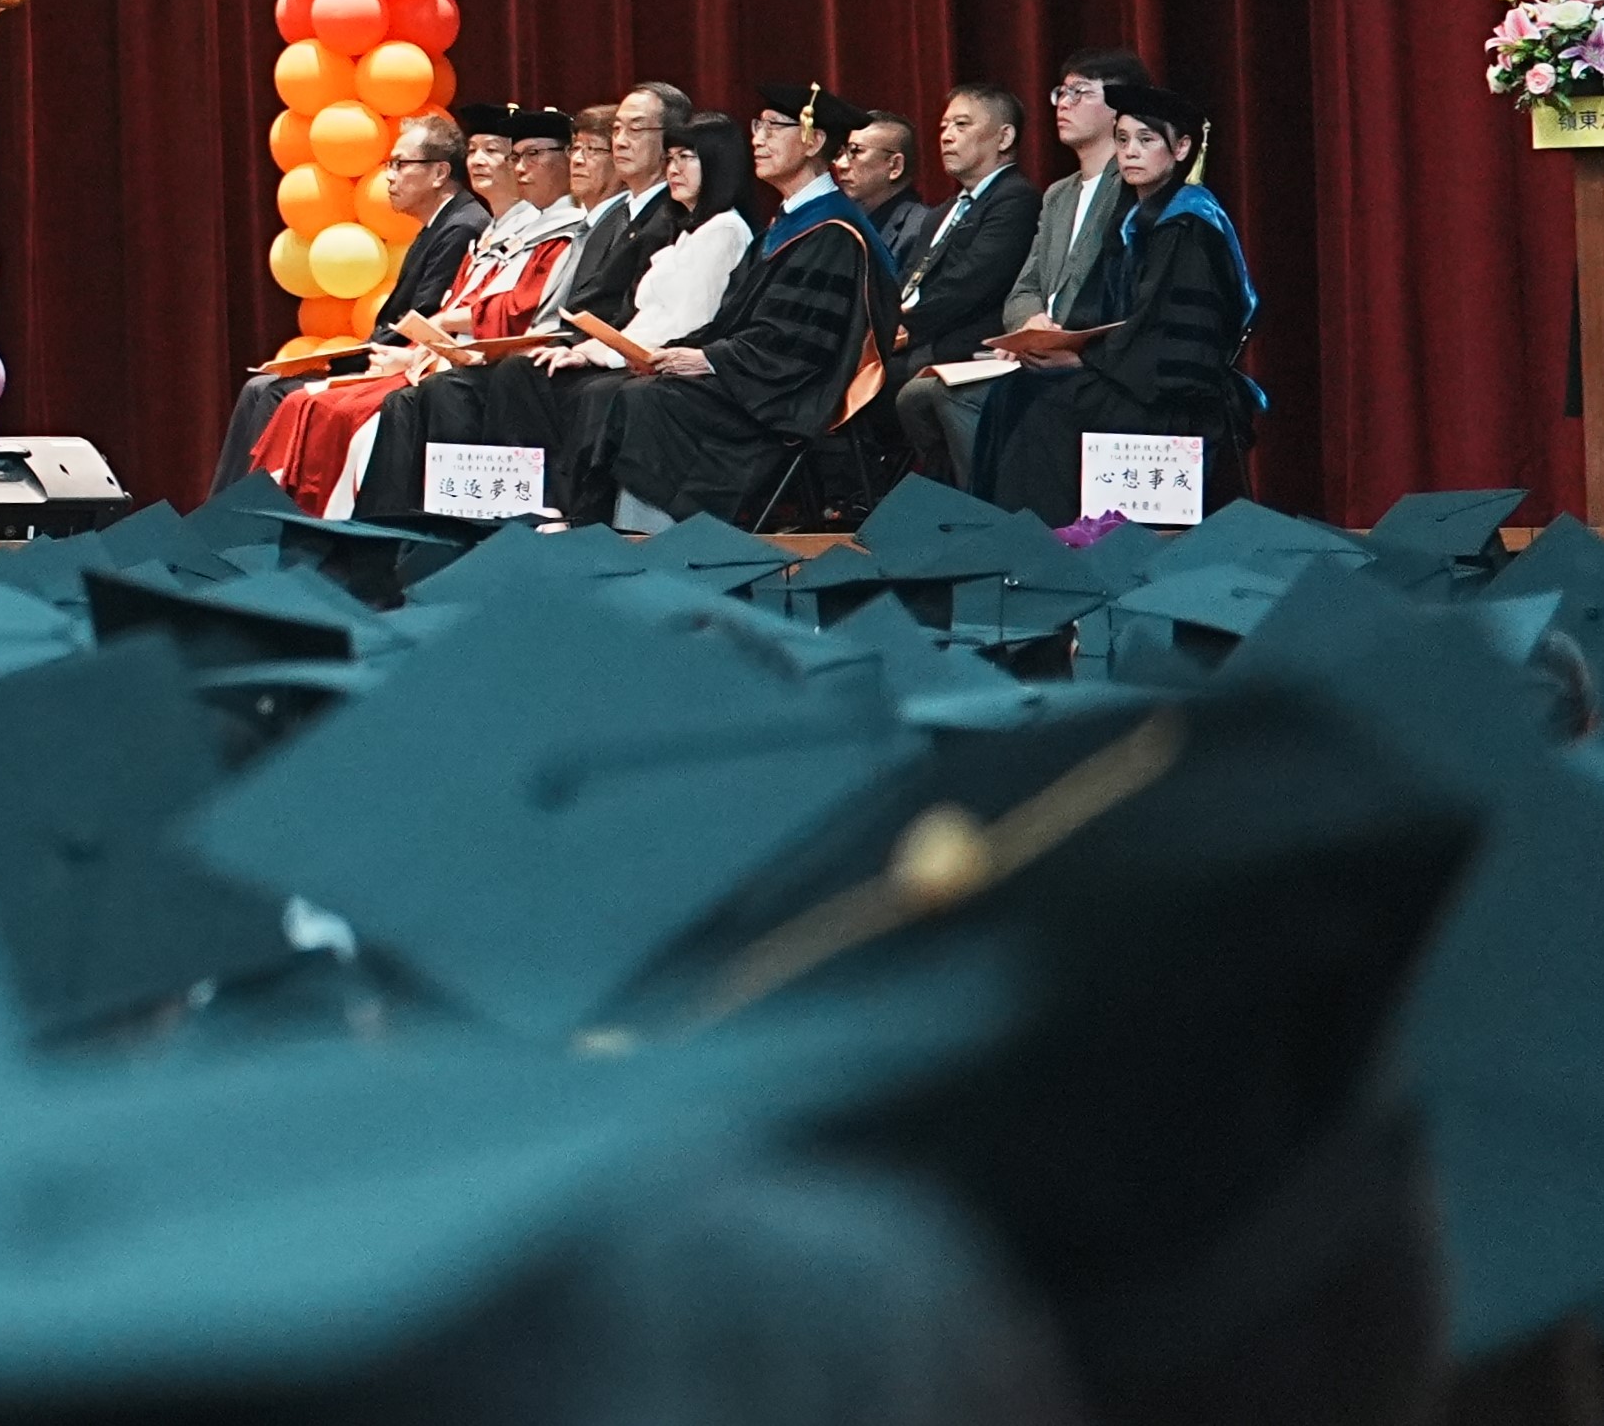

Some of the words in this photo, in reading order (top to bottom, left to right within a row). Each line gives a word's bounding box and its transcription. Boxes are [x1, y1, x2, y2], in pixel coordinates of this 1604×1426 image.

[1558, 110, 1604, 131] 嶺東
[439, 477, 532, 501] 追逐夢想
[1095, 468, 1192, 491] 心想事成
